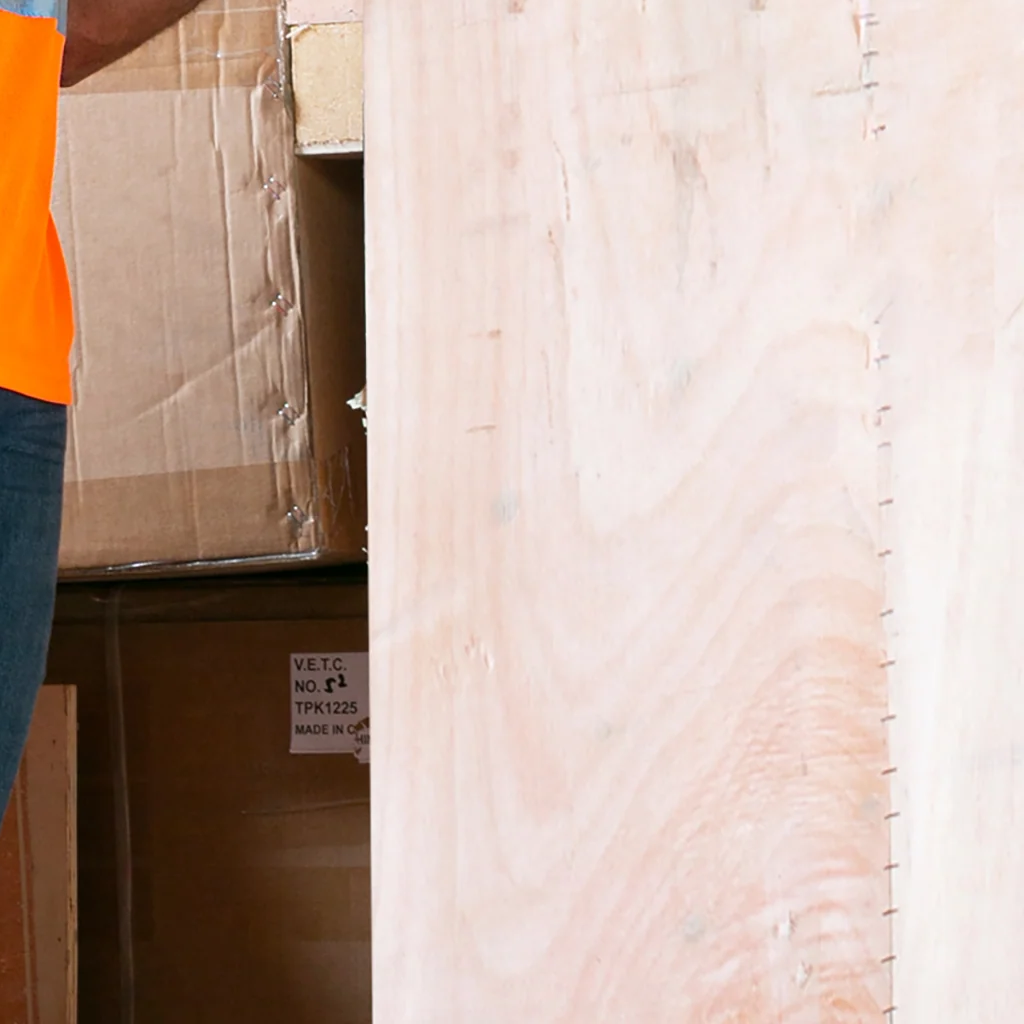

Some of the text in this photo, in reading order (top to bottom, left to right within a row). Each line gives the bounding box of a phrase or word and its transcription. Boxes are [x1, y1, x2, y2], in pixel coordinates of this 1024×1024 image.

[294, 658, 347, 671] V.E.T.C.
[295, 680, 321, 693] NO.
[295, 701, 358, 714] TPK1225
[295, 724, 329, 735] MADE
[332, 724, 344, 734] IN
